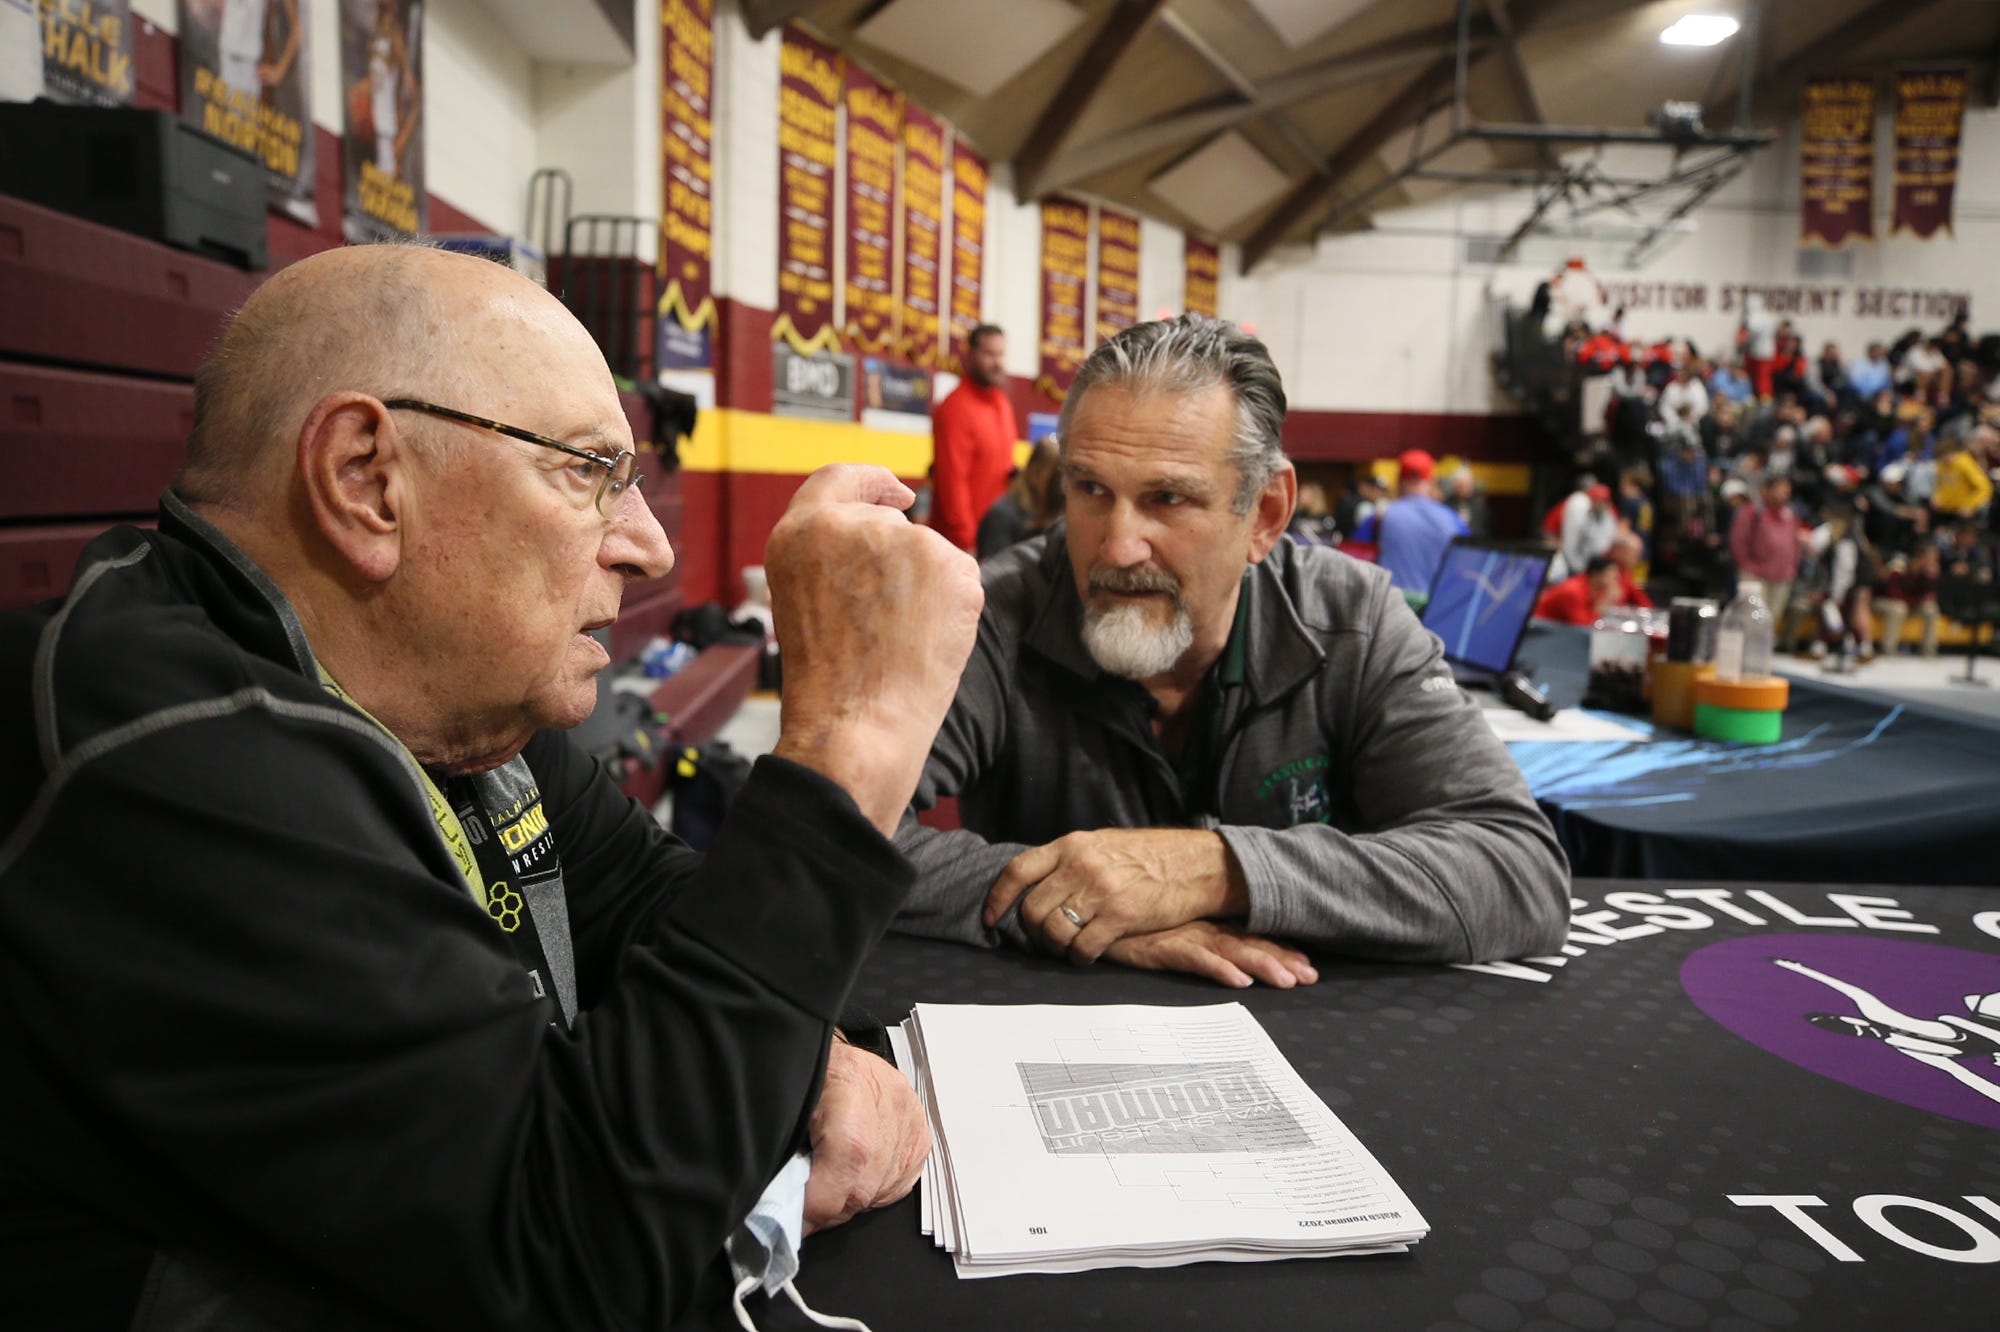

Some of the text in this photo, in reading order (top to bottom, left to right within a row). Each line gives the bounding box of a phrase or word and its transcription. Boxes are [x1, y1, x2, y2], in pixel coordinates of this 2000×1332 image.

[1855, 288, 1973, 321] SECTION
[1325, 1215, 1368, 1225] Ironman
[1368, 1211, 1401, 1220] Walsh
[1029, 1227, 1047, 1235] 106
[1725, 1194, 2000, 1263] TO
